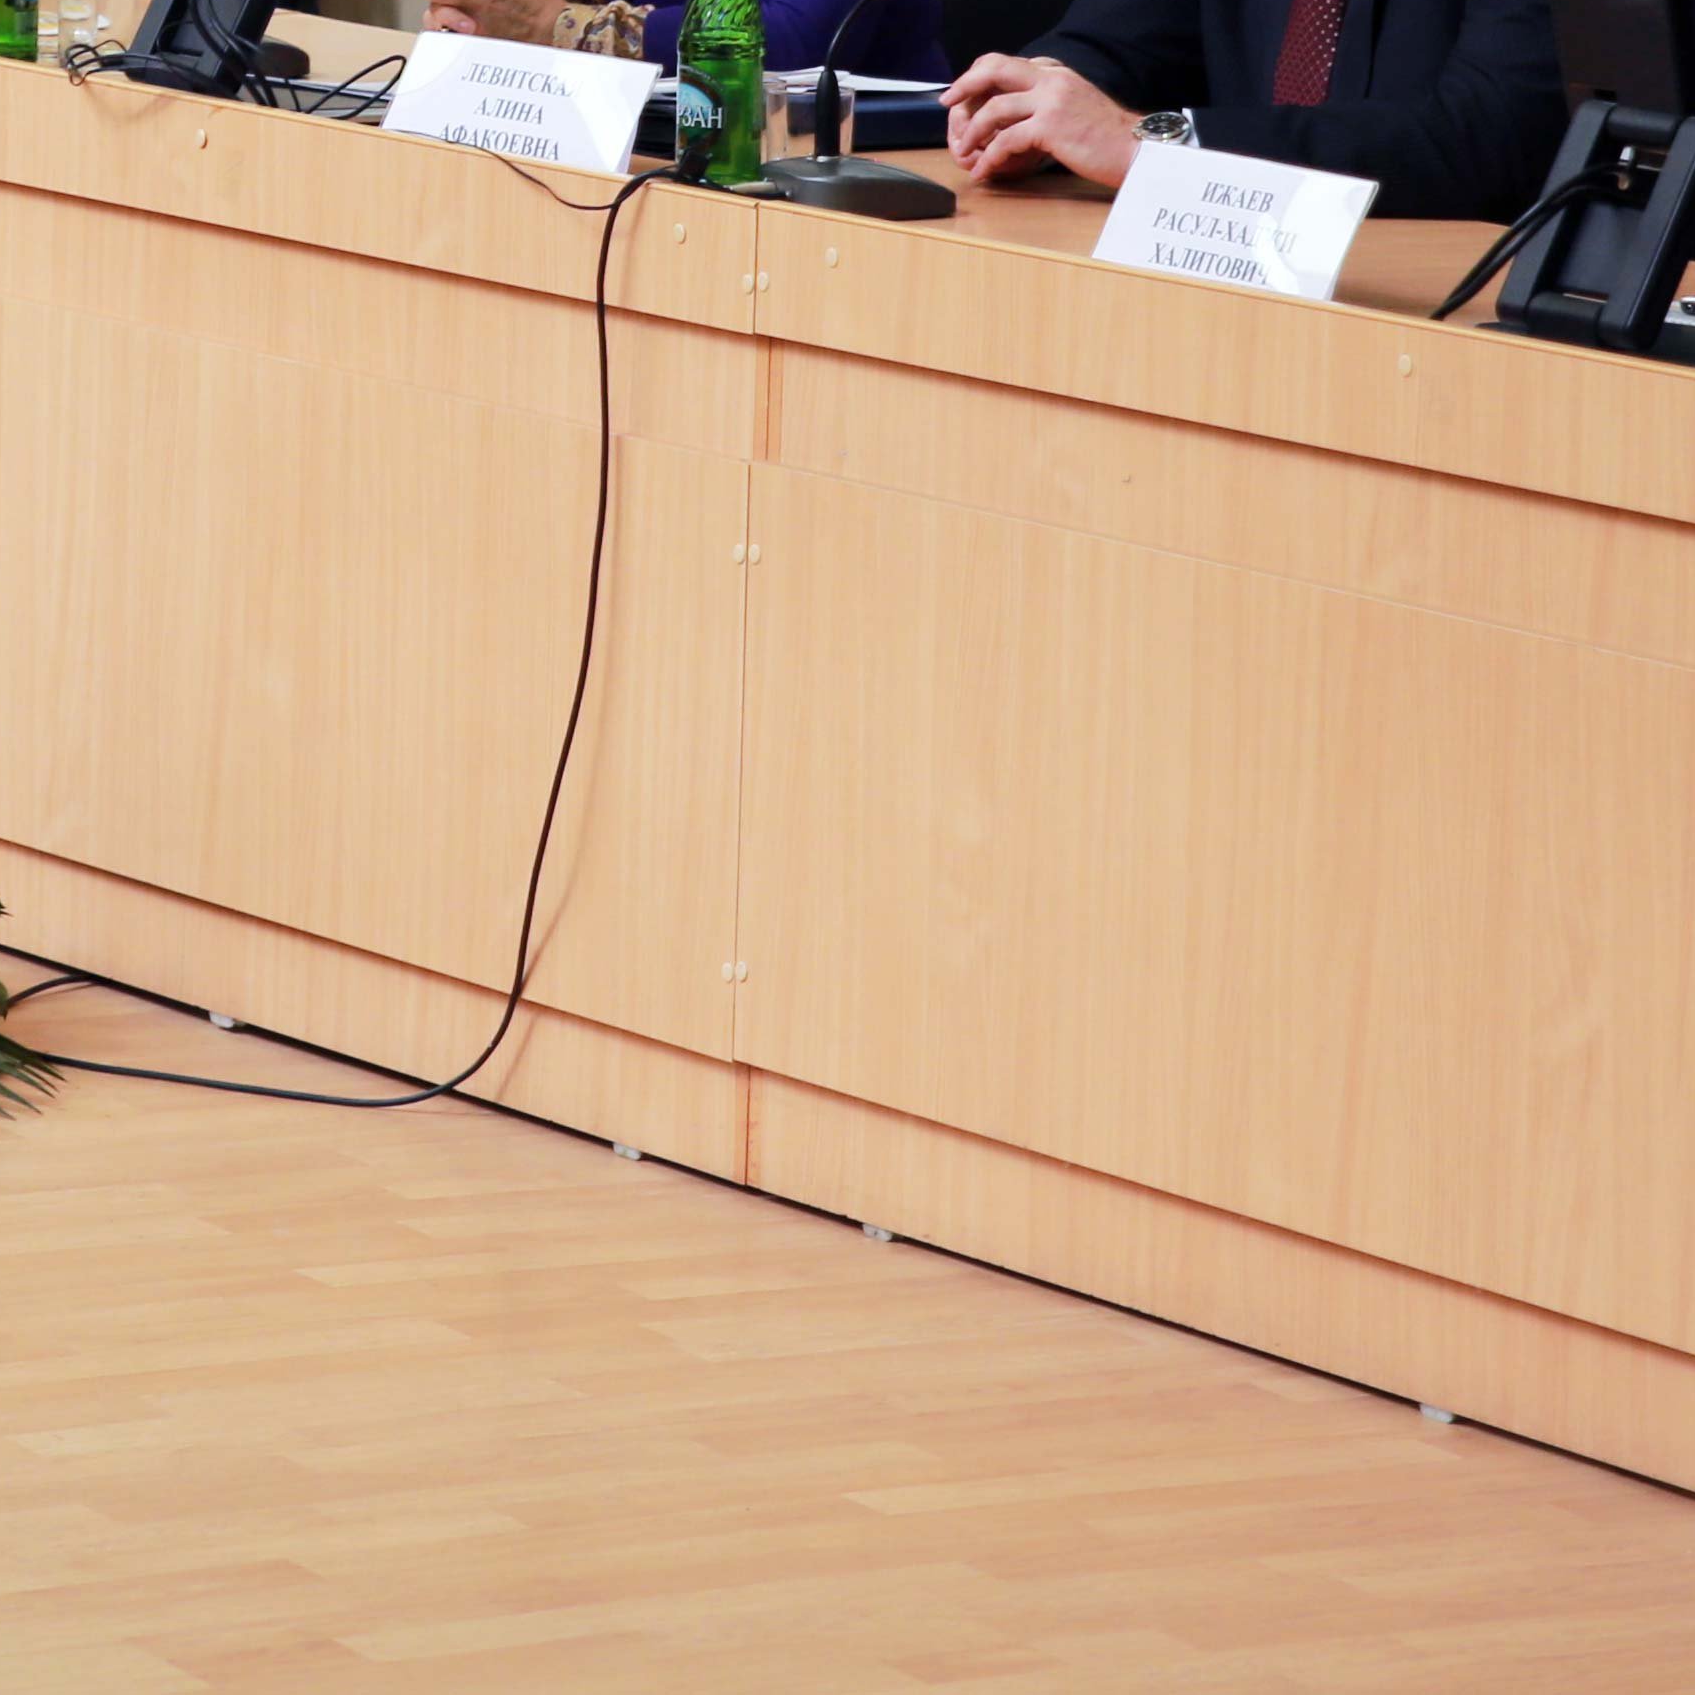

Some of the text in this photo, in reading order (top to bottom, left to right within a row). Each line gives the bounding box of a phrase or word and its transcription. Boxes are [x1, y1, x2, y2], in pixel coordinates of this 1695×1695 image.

[461, 63, 582, 97] ЛЕВИТСКА
[473, 98, 544, 125] АЛИНА
[439, 123, 561, 161] АФАКОЕВНА
[1200, 181, 1275, 213] ИЖАЕВ
[1147, 242, 1272, 286] ХАЛИТОВИЧ
